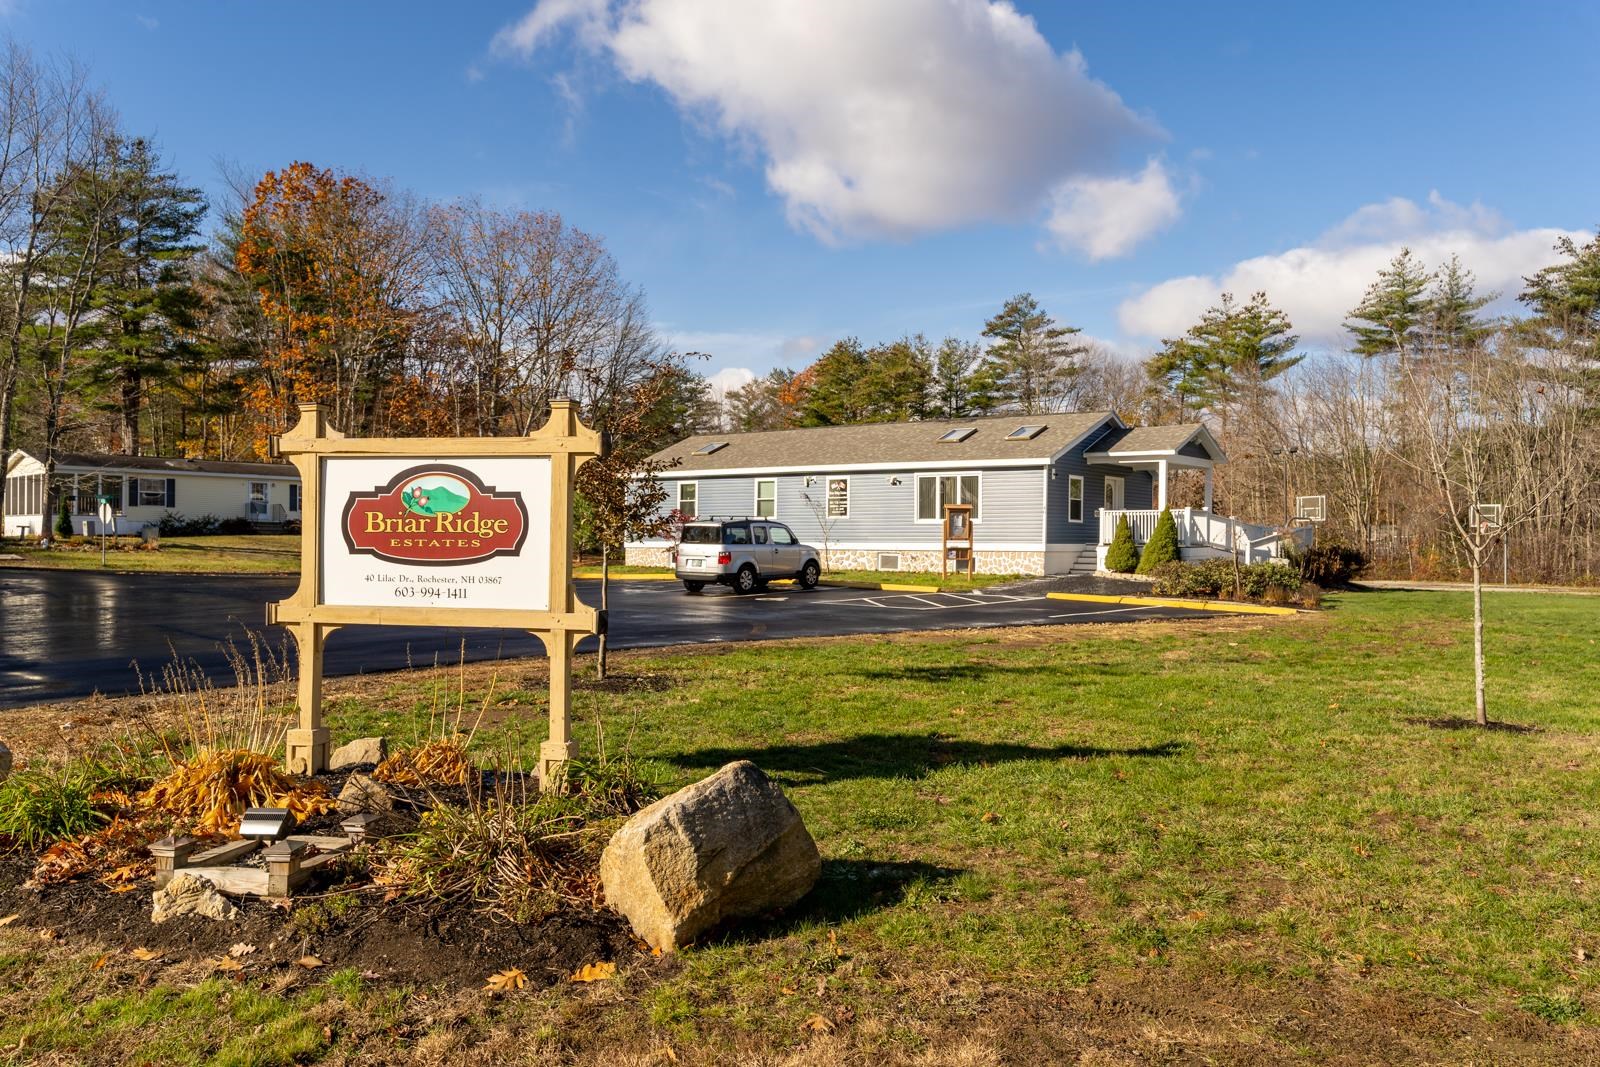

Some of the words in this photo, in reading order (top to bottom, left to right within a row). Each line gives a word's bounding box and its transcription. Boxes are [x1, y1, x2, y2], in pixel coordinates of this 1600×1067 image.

[364, 511, 431, 533] Briar
[433, 511, 509, 539] Ridge
[390, 539, 481, 547] ESTATES
[364, 574, 375, 582] 40
[377, 574, 396, 582] Lilac
[417, 575, 458, 584] Rochester,
[461, 576, 475, 584] NH
[478, 576, 502, 585] 03867
[394, 586, 467, 599] 603-994-1411
